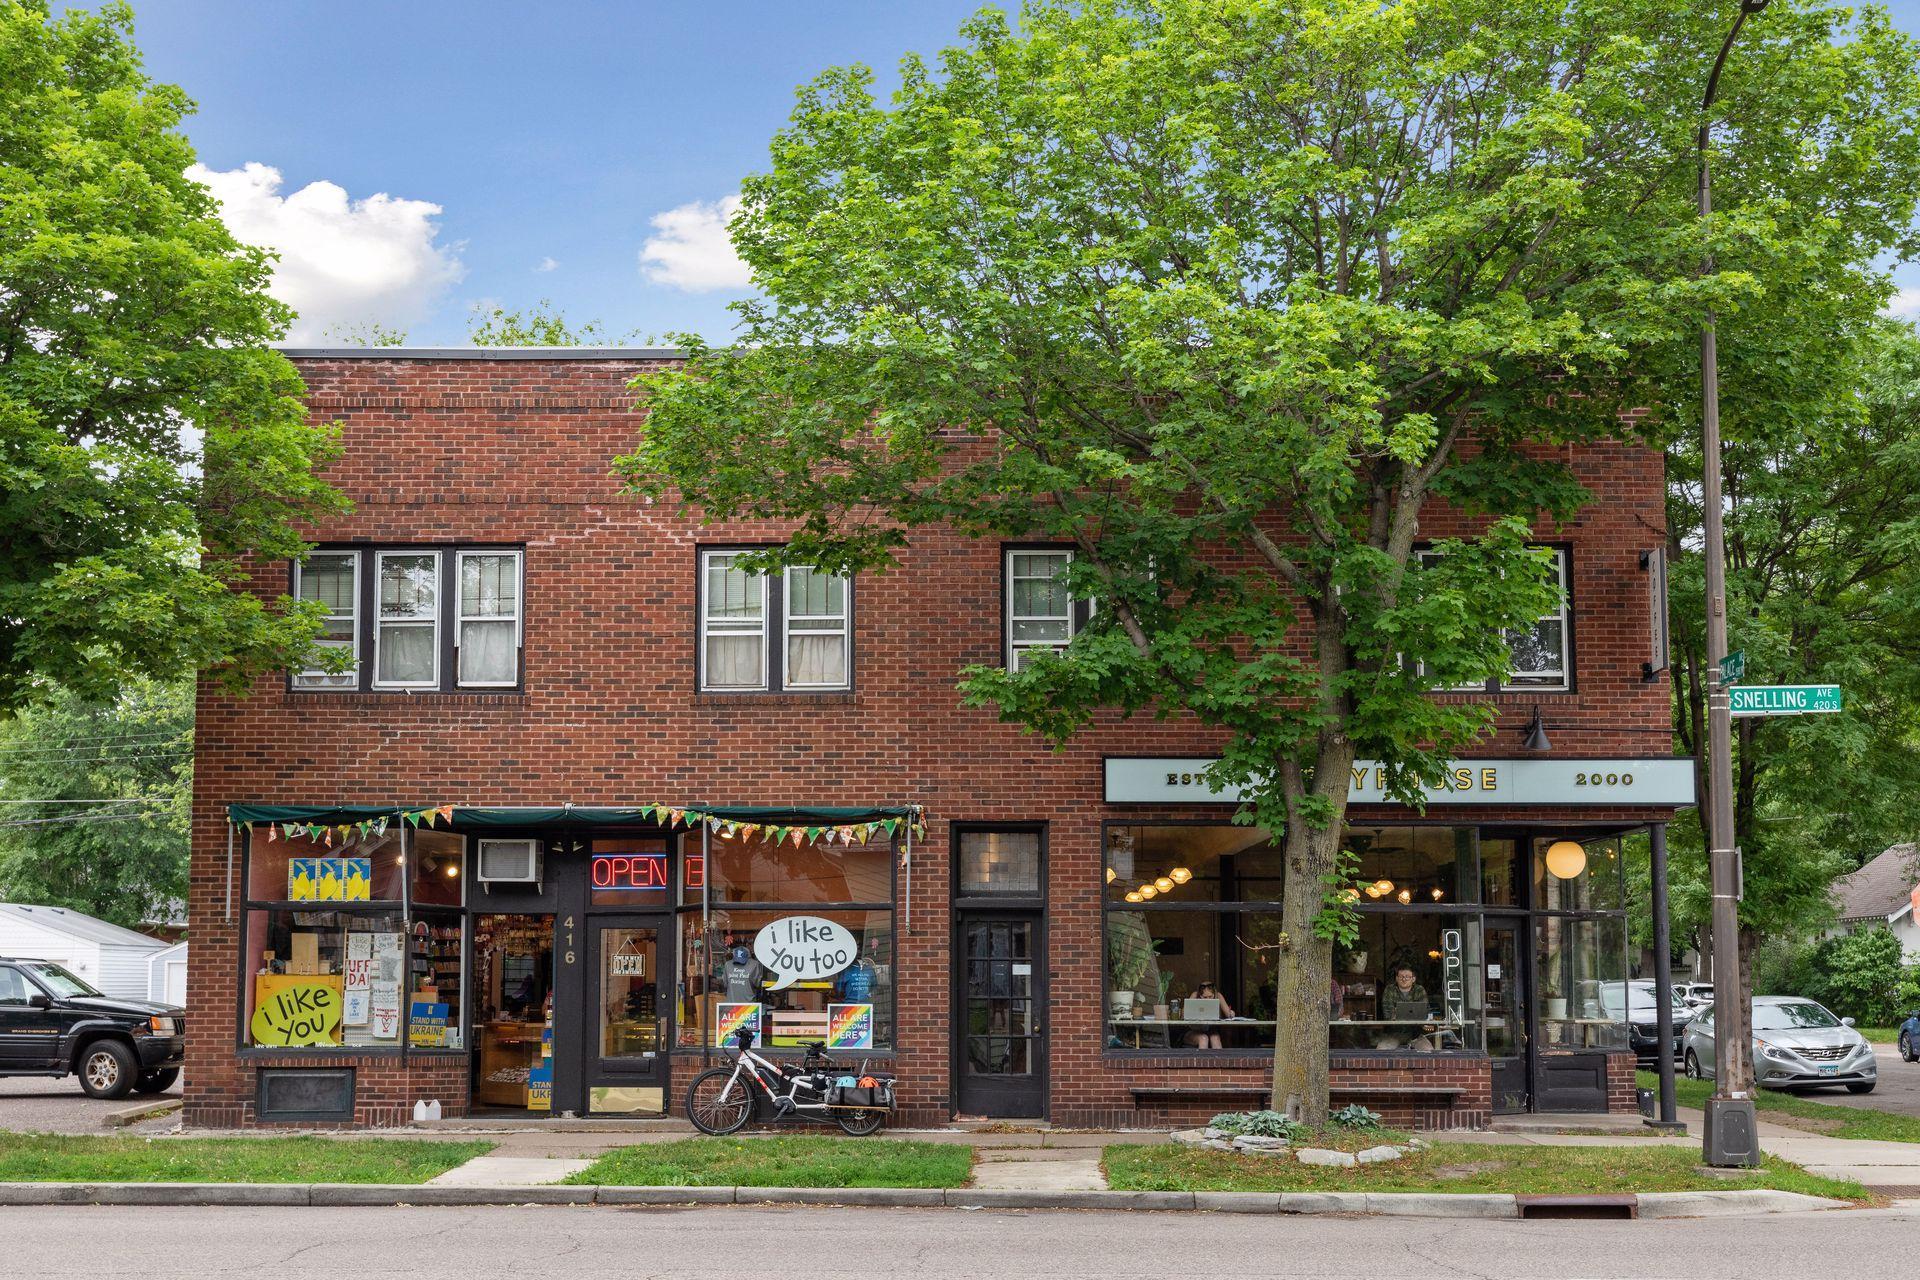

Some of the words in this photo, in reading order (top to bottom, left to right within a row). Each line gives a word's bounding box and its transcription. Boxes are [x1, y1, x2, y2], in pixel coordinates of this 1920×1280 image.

[1733, 691, 1807, 708] SNELLING
[1816, 689, 1832, 698] AVE
[1813, 701, 1829, 710] 420
[1832, 701, 1838, 710] S
[1575, 772, 1634, 786] 2000
[593, 858, 667, 887] OPEN
[771, 926, 777, 944] i
[788, 920, 834, 944] like
[564, 915, 575, 964] 416
[349, 960, 370, 973] UFF
[613, 960, 643, 970] OPEN
[810, 948, 847, 974] too
[1446, 931, 1462, 1026] OPEN
[262, 1007, 273, 1026] i
[276, 988, 331, 1021] like
[411, 1016, 430, 1024] STAND
[431, 1017, 446, 1025] WITH
[721, 1013, 737, 1021] ALL
[740, 1013, 757, 1021] ARE
[832, 1014, 848, 1022] ALL
[850, 1014, 868, 1022] ARE
[410, 1026, 443, 1035] UKRAINE
[832, 1031, 858, 1040] HERE
